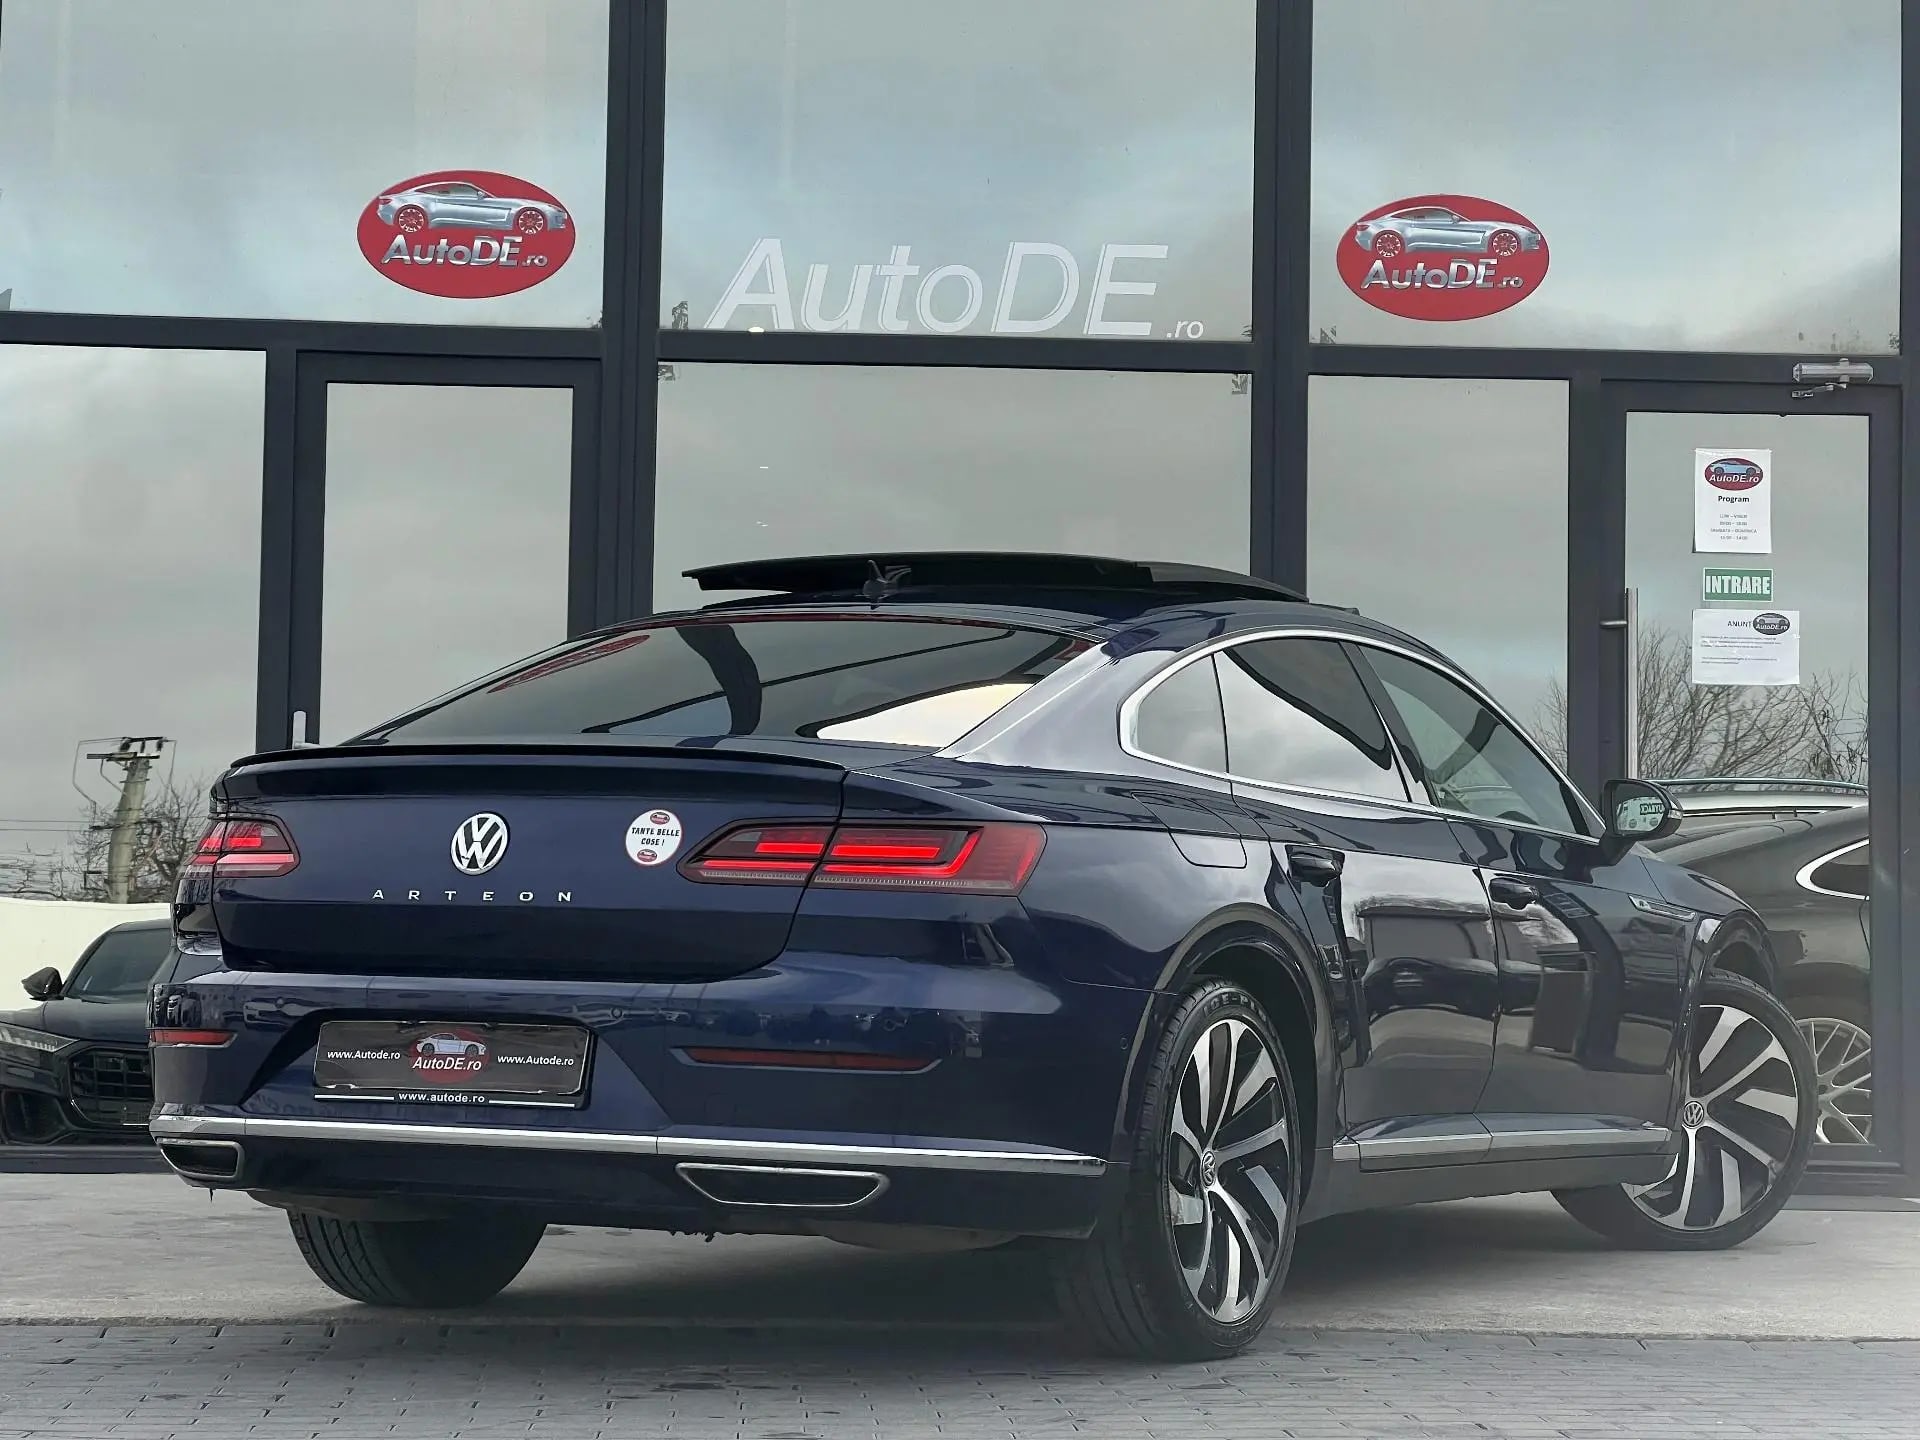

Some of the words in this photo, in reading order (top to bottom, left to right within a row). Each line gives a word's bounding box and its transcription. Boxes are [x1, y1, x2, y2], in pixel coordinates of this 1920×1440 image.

[1708, 473, 1760, 484] AutoDE.ro
[1717, 495, 1750, 504] Program
[1705, 575, 1771, 595] INTRARE
[631, 827, 655, 835] TANTE
[656, 828, 681, 837] BELLE
[372, 889, 572, 902] ARTEON
[327, 1050, 401, 1060] www.Autode.ro
[497, 1054, 574, 1066] www.Autode.ro
[412, 1056, 482, 1071] AutoDE.ro
[398, 1091, 485, 1103] www.autode.ro
